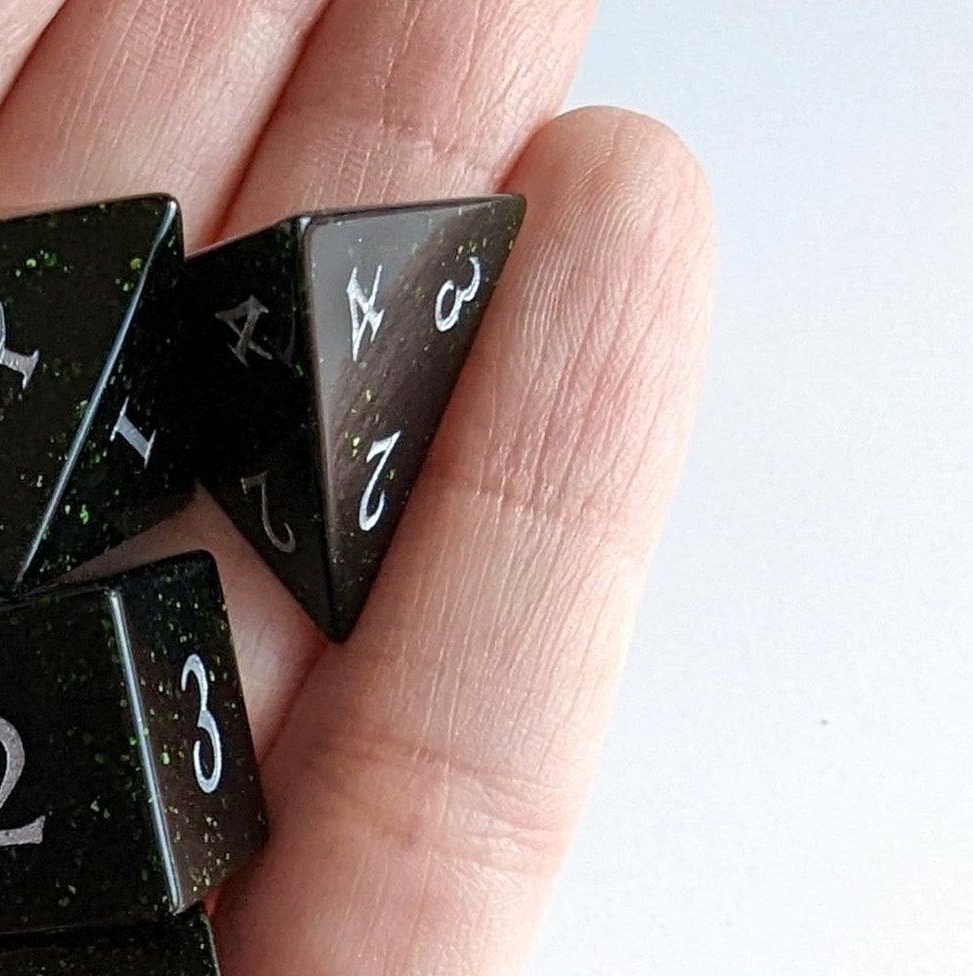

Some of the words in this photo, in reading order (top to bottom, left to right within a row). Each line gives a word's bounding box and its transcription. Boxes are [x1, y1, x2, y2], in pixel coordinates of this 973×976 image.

[343, 262, 385, 362] 4
[434, 255, 483, 332] 3
[109, 395, 159, 468] 1
[358, 430, 402, 533] 2
[180, 653, 224, 794] 3
